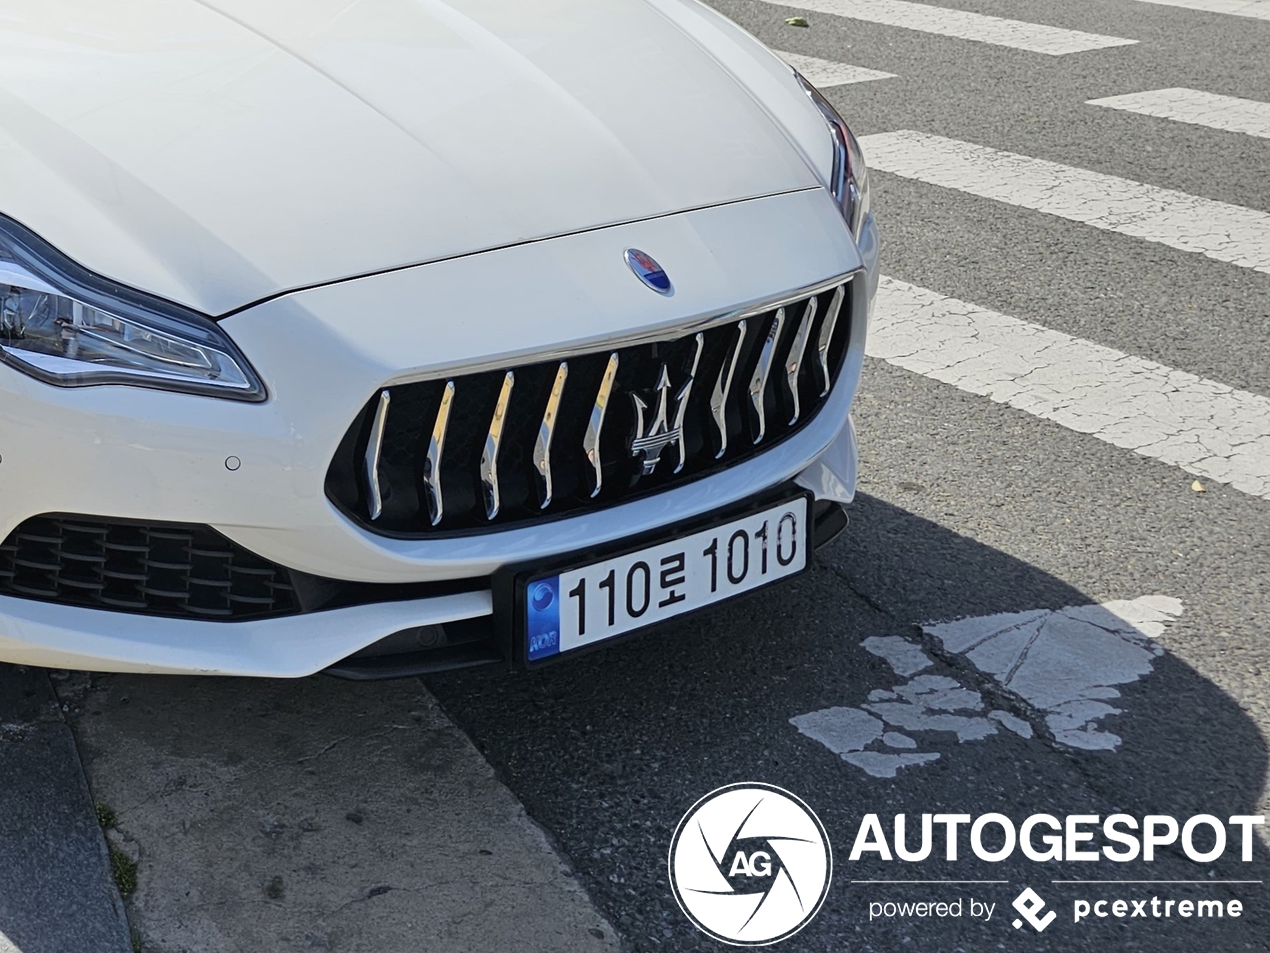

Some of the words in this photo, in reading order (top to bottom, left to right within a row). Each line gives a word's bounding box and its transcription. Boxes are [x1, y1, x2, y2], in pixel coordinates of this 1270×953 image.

[568, 551, 686, 636] 110로
[702, 511, 797, 593] 1010
[529, 630, 558, 652] KOR
